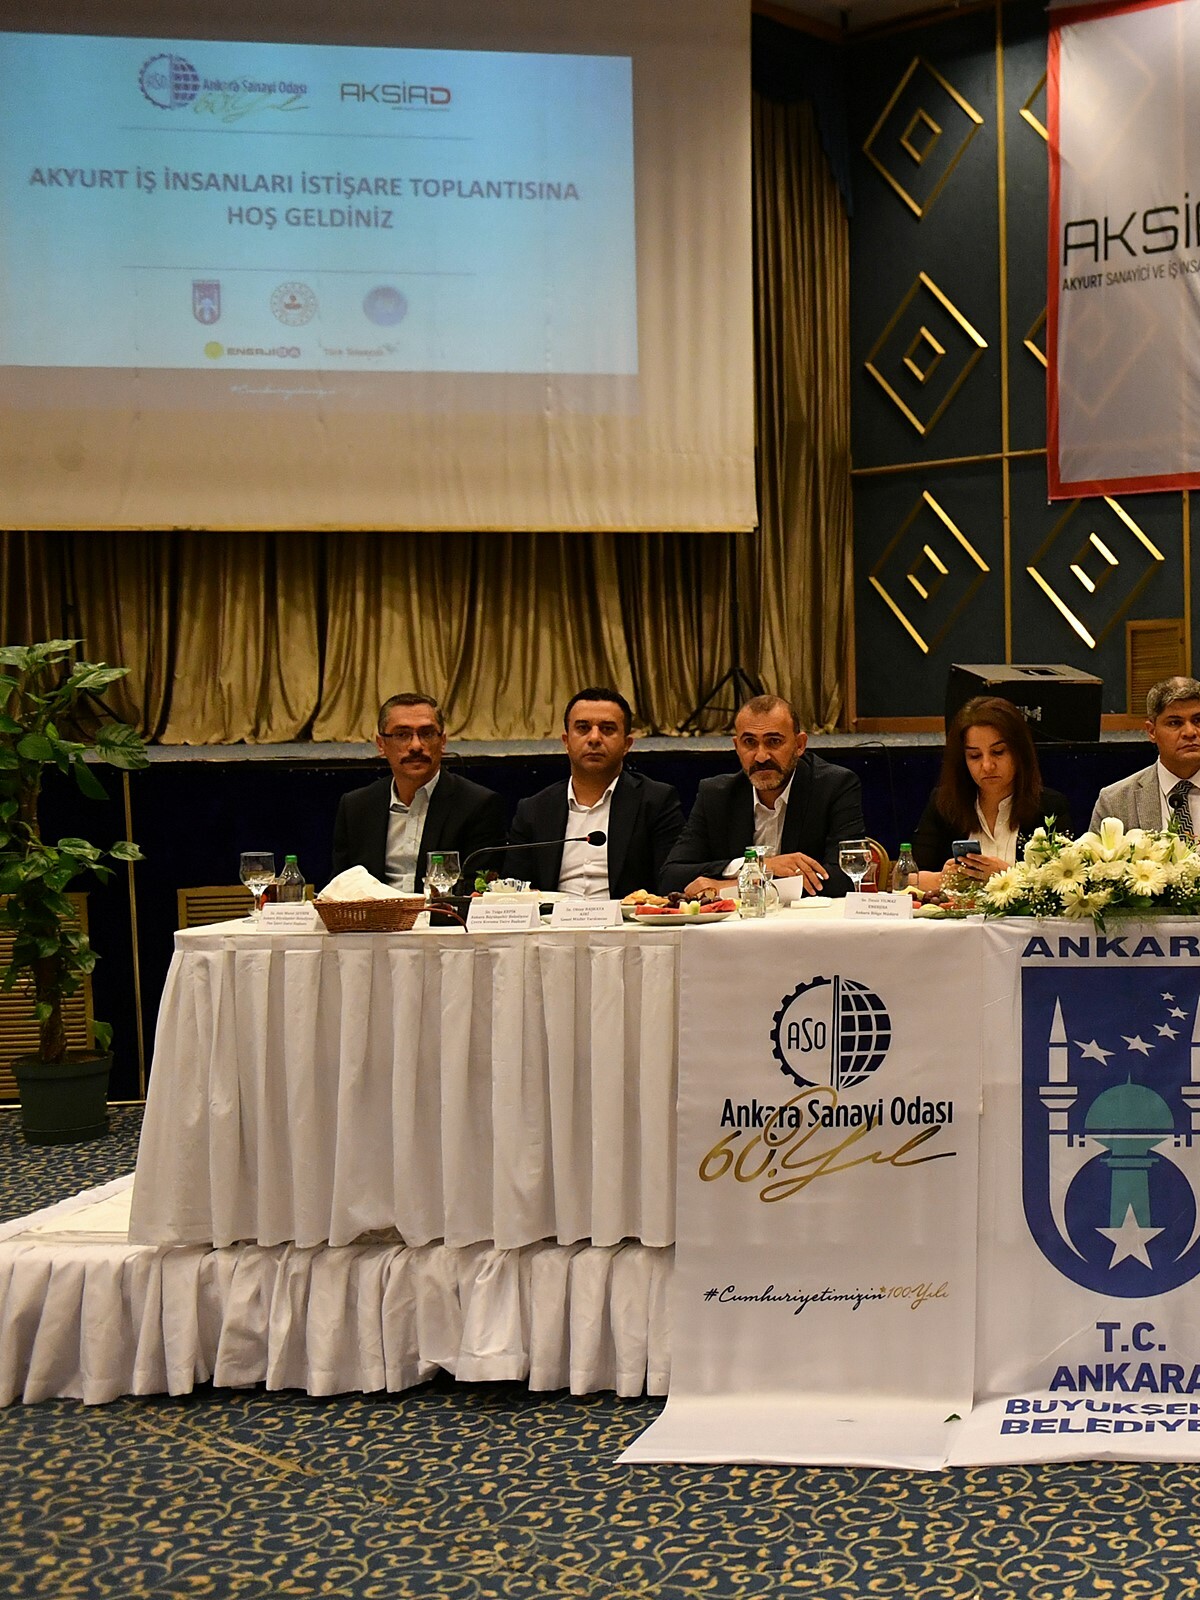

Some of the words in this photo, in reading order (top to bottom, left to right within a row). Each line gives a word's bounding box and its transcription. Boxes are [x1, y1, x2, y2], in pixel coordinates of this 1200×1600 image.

[340, 81, 452, 105] AKSİAD
[29, 167, 129, 189] AKYURT
[136, 166, 158, 194] İŞ
[164, 166, 293, 194] İNSANLARI
[300, 171, 402, 199] İSTİŞARE
[409, 177, 581, 201] TOPLANTISINA
[227, 206, 278, 231] HOŞ
[284, 205, 394, 229] GELDİNİZ
[1062, 273, 1104, 292] AKYURT
[1106, 264, 1151, 286] SANAYİCİ
[1152, 264, 1165, 280] VE
[1168, 259, 1179, 280] İŞ
[787, 1017, 827, 1053] ASO
[720, 1098, 801, 1128] Ankara
[807, 1098, 884, 1132] Sanayi
[890, 1095, 954, 1125] Odası
[1096, 1321, 1167, 1353] T.C.
